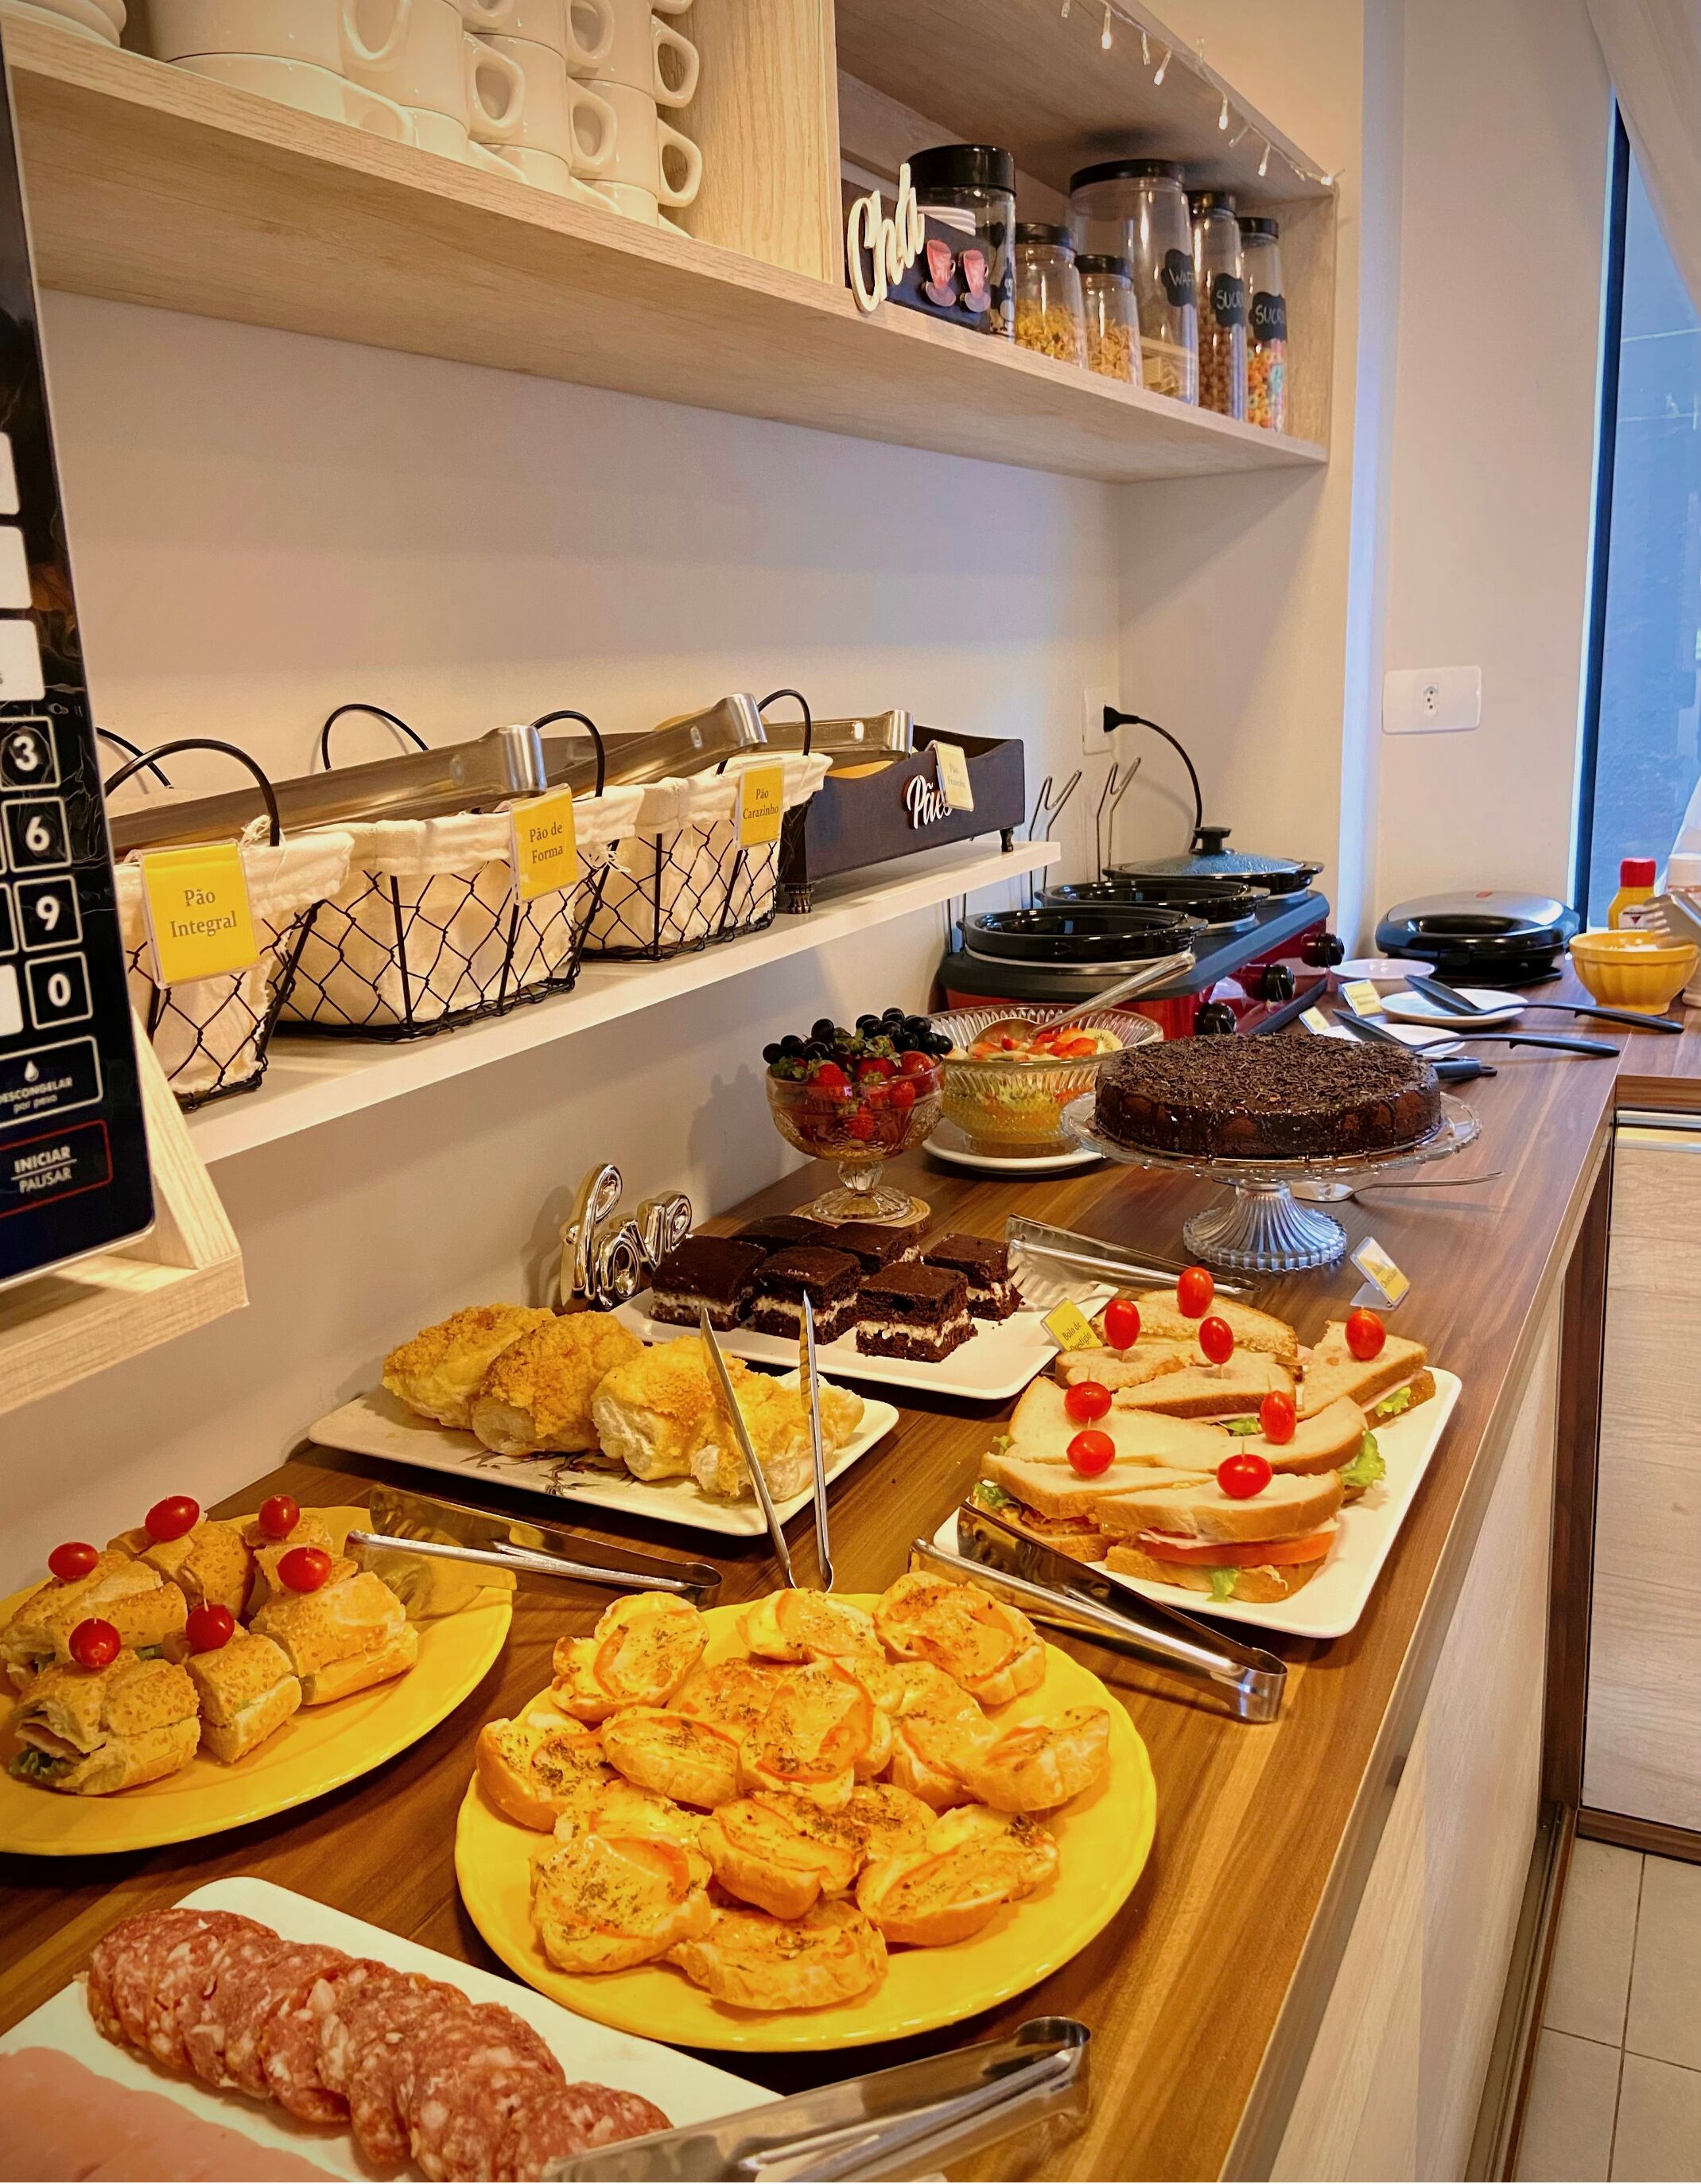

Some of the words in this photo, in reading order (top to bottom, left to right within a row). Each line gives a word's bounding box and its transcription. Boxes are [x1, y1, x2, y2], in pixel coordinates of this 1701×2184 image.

[13, 735, 38, 771] 3
[755, 788, 769, 800] Pão
[743, 803, 779, 819] Carazinho
[25, 816, 50, 852] 6
[530, 826, 549, 843] Pão
[550, 822, 563, 837] de
[531, 845, 564, 864] Forma
[183, 888, 216, 907] Pão
[36, 896, 60, 931] 9
[169, 910, 237, 938] Integral
[48, 973, 72, 1007] 0
[14, 1145, 71, 1173] INICIAR
[19, 1167, 72, 1193] PAUSAR
[561, 1164, 693, 1311] love
[1062, 1326, 1076, 1341] Bolo
